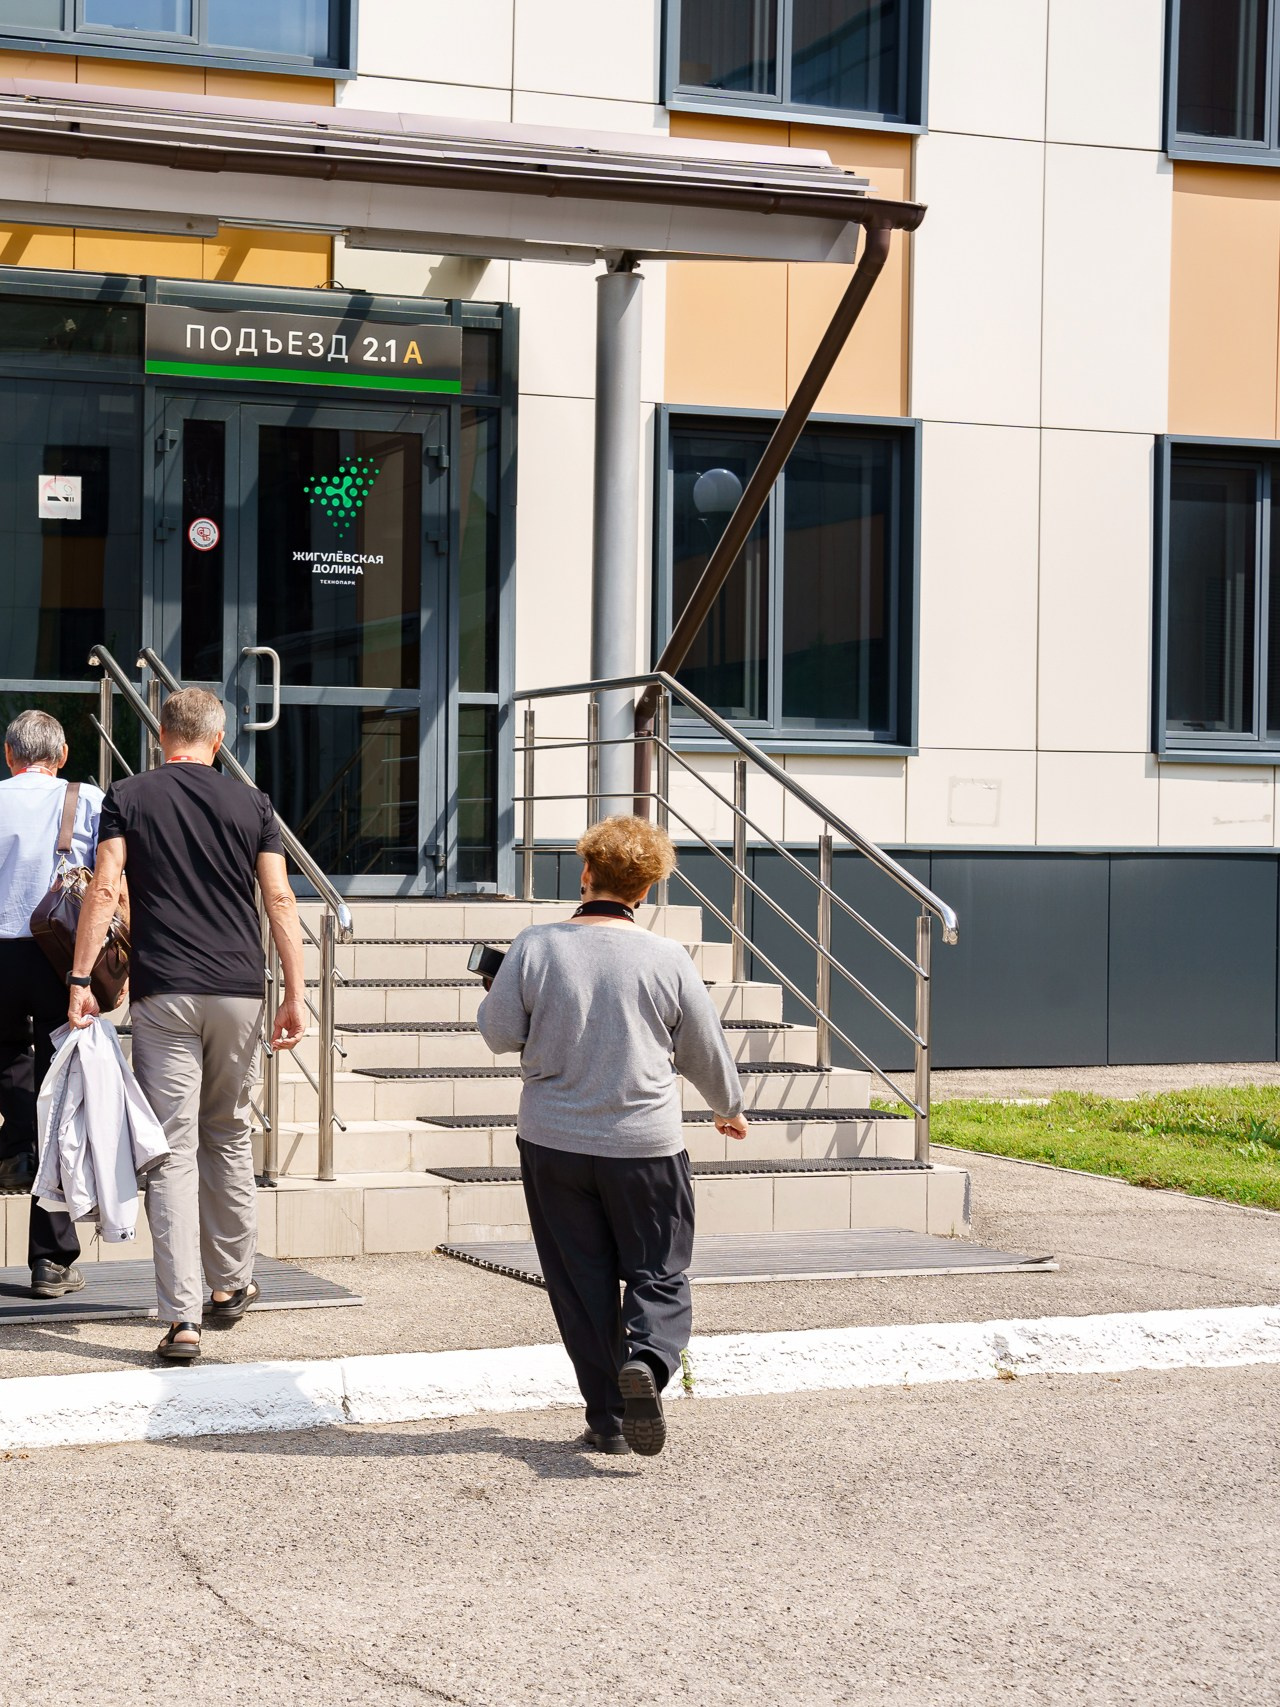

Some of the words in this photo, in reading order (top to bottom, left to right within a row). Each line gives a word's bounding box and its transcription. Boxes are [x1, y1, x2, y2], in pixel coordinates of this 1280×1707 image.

[185, 324, 349, 363] ПОДЪЕЗД
[292, 550, 384, 565] ЖИГУЛЁВСКАЯ
[311, 564, 364, 575] ДОЛИНА
